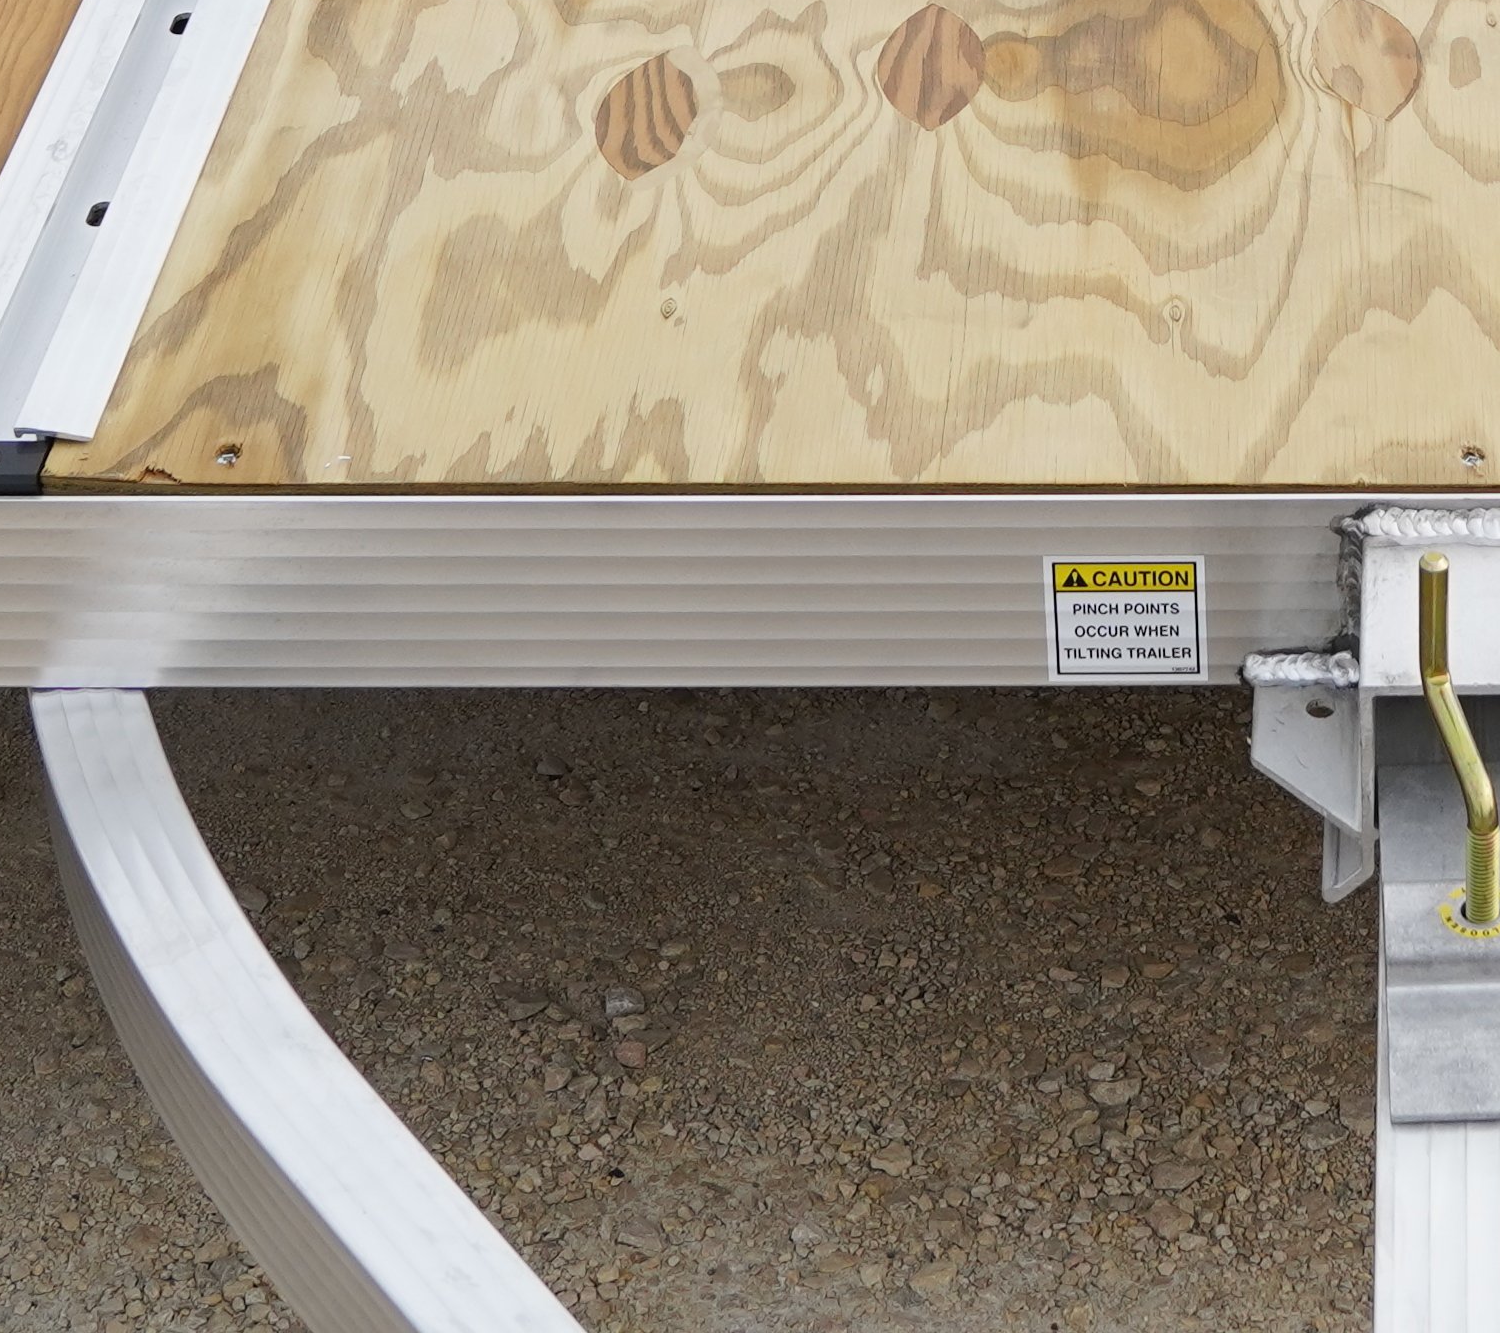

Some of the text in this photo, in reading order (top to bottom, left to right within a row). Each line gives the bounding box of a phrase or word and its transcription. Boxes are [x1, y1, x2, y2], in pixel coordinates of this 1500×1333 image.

[1092, 570, 1189, 587] CAUTION
[1073, 602, 1180, 615] PINCH POINTS
[1074, 625, 1180, 638] OCCUR WHEN
[1064, 647, 1192, 659] TILTING TRAILER
